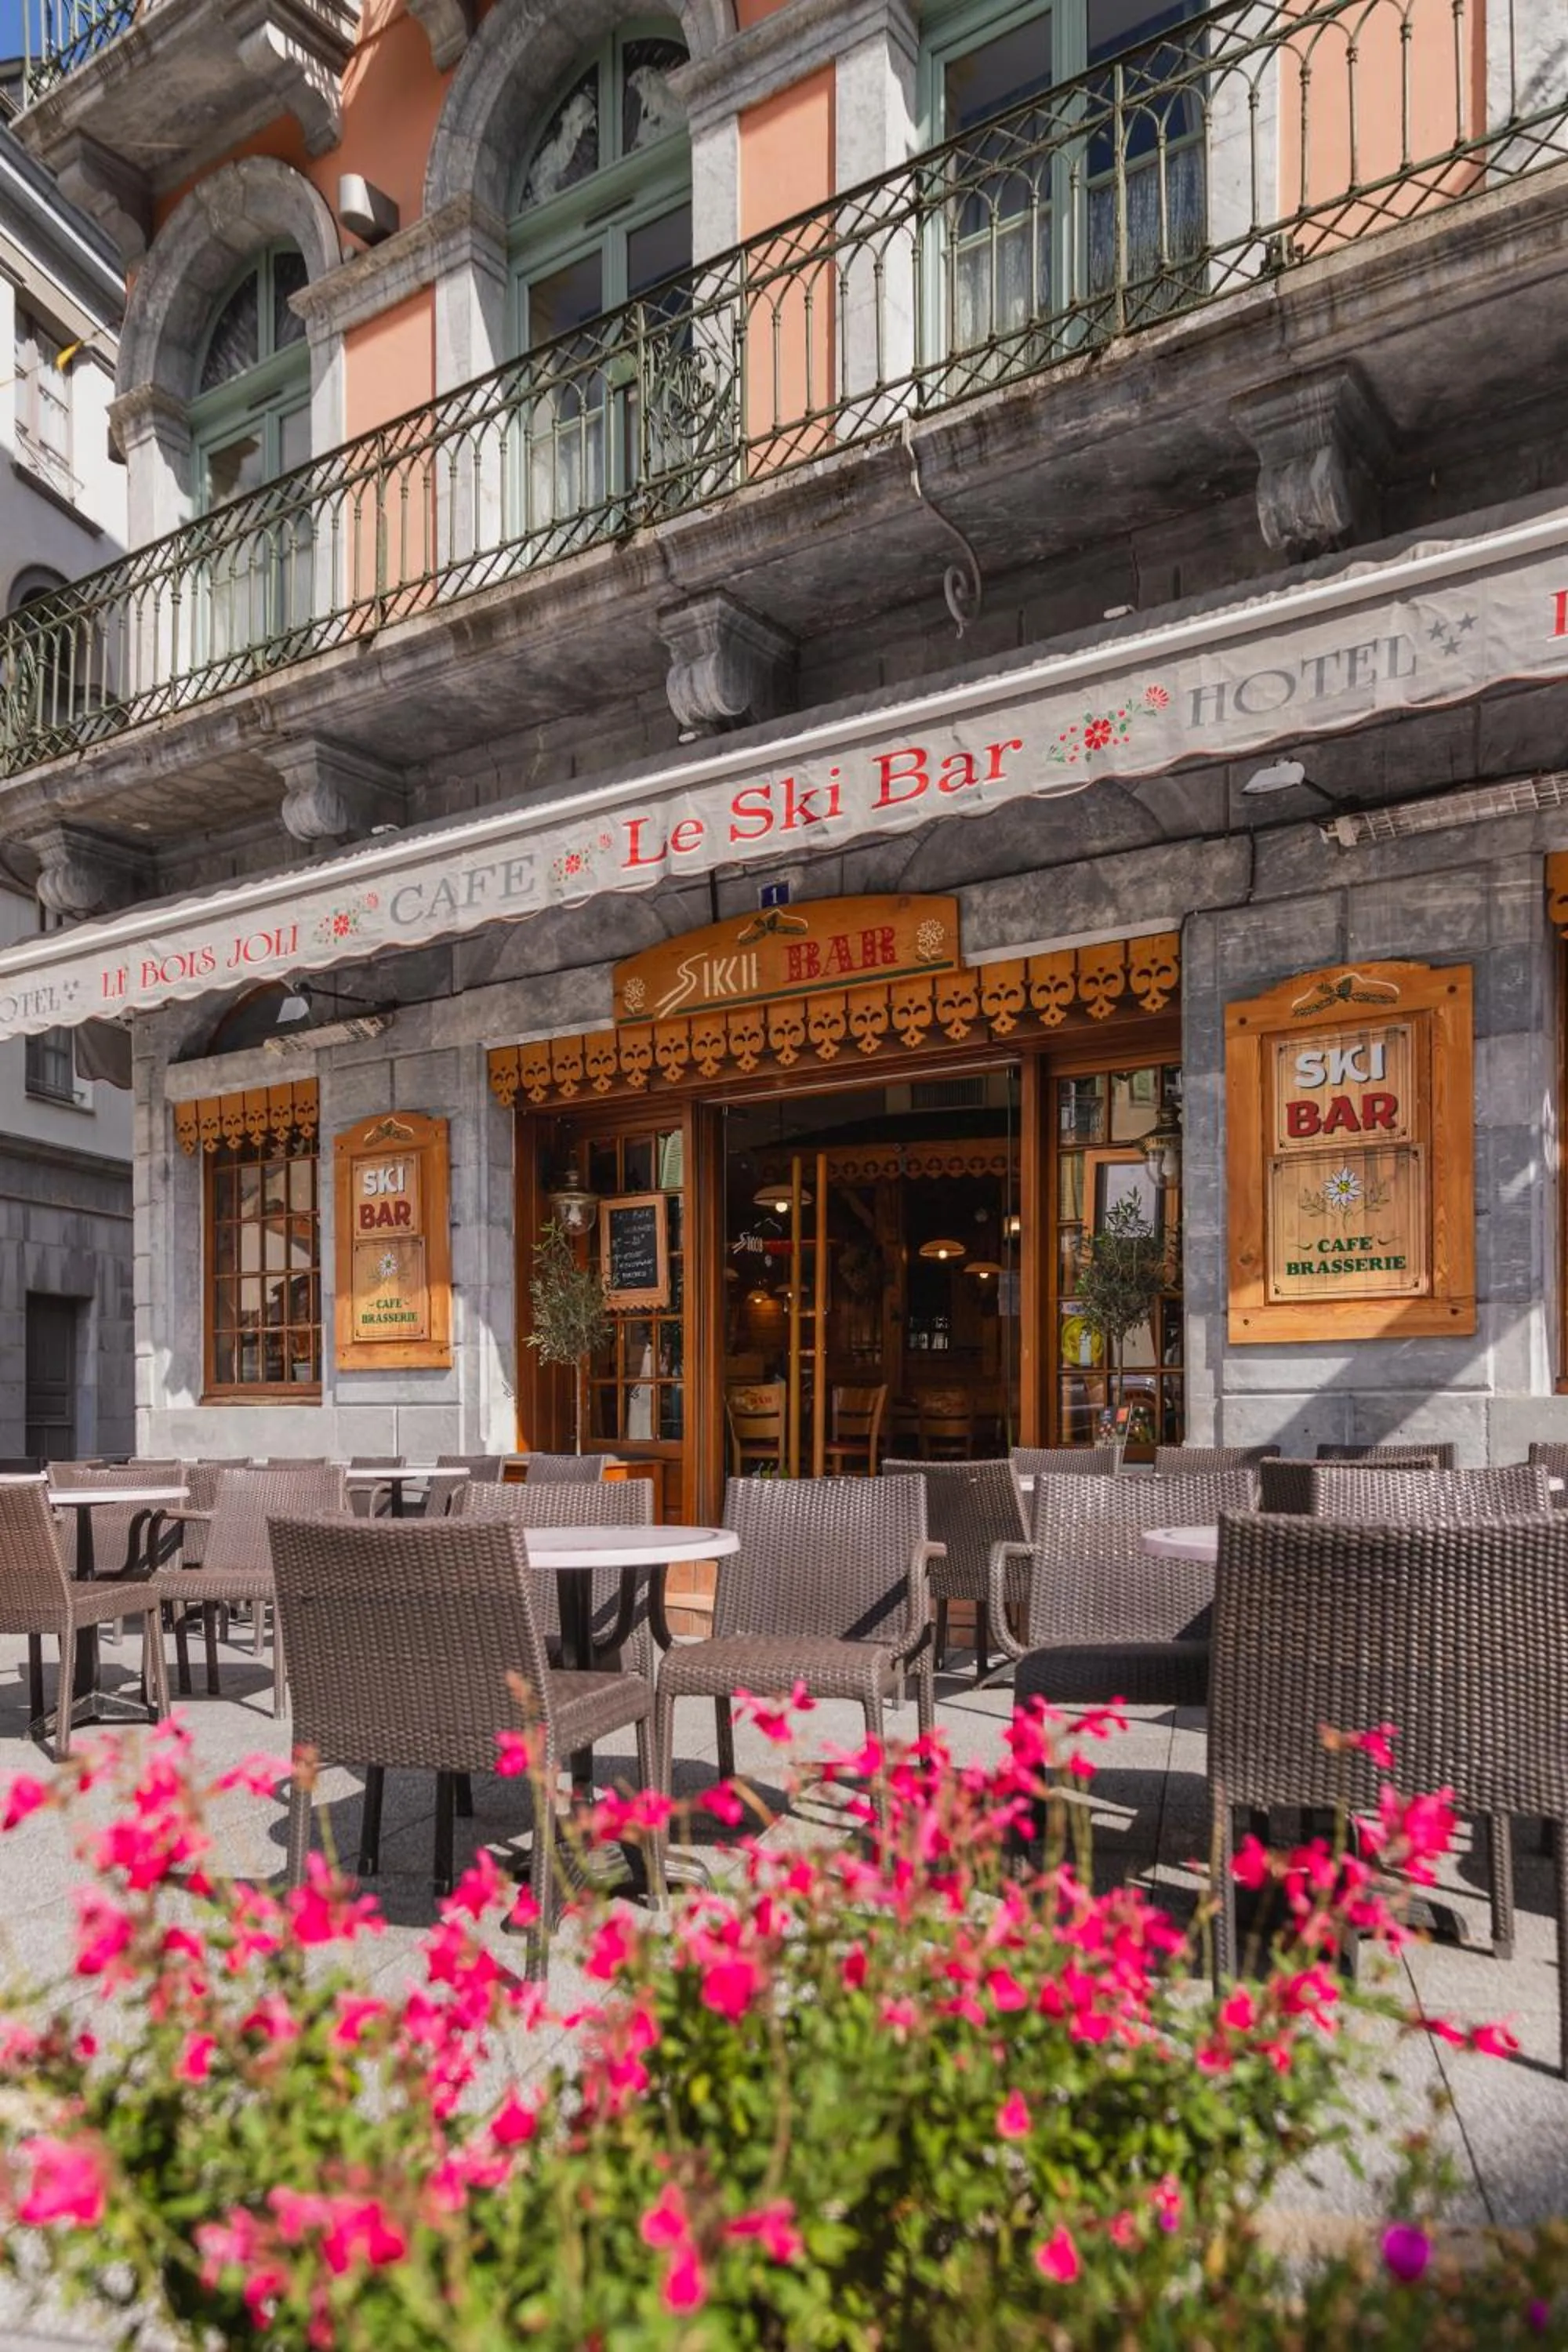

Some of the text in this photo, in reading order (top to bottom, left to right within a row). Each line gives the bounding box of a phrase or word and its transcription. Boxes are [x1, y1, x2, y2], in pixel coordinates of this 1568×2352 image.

[1189, 634, 1417, 728] HOTEL
[621, 739, 1023, 867] Le Ski Bar
[390, 854, 535, 926] CAFE
[771, 887, 778, 904] 1
[141, 946, 216, 988] BOIS
[227, 925, 299, 967] JOLI
[783, 925, 898, 983] BAR
[1294, 1043, 1385, 1088] SKI
[1286, 1092, 1399, 1140] BAR
[363, 1166, 405, 1196] SKI
[359, 1200, 411, 1229] BAR
[1317, 1236, 1373, 1253] CAFE
[1287, 1255, 1406, 1276] BRASSERIE
[361, 1312, 417, 1324] BRASSERIE
[376, 1298, 402, 1308] CAFE
